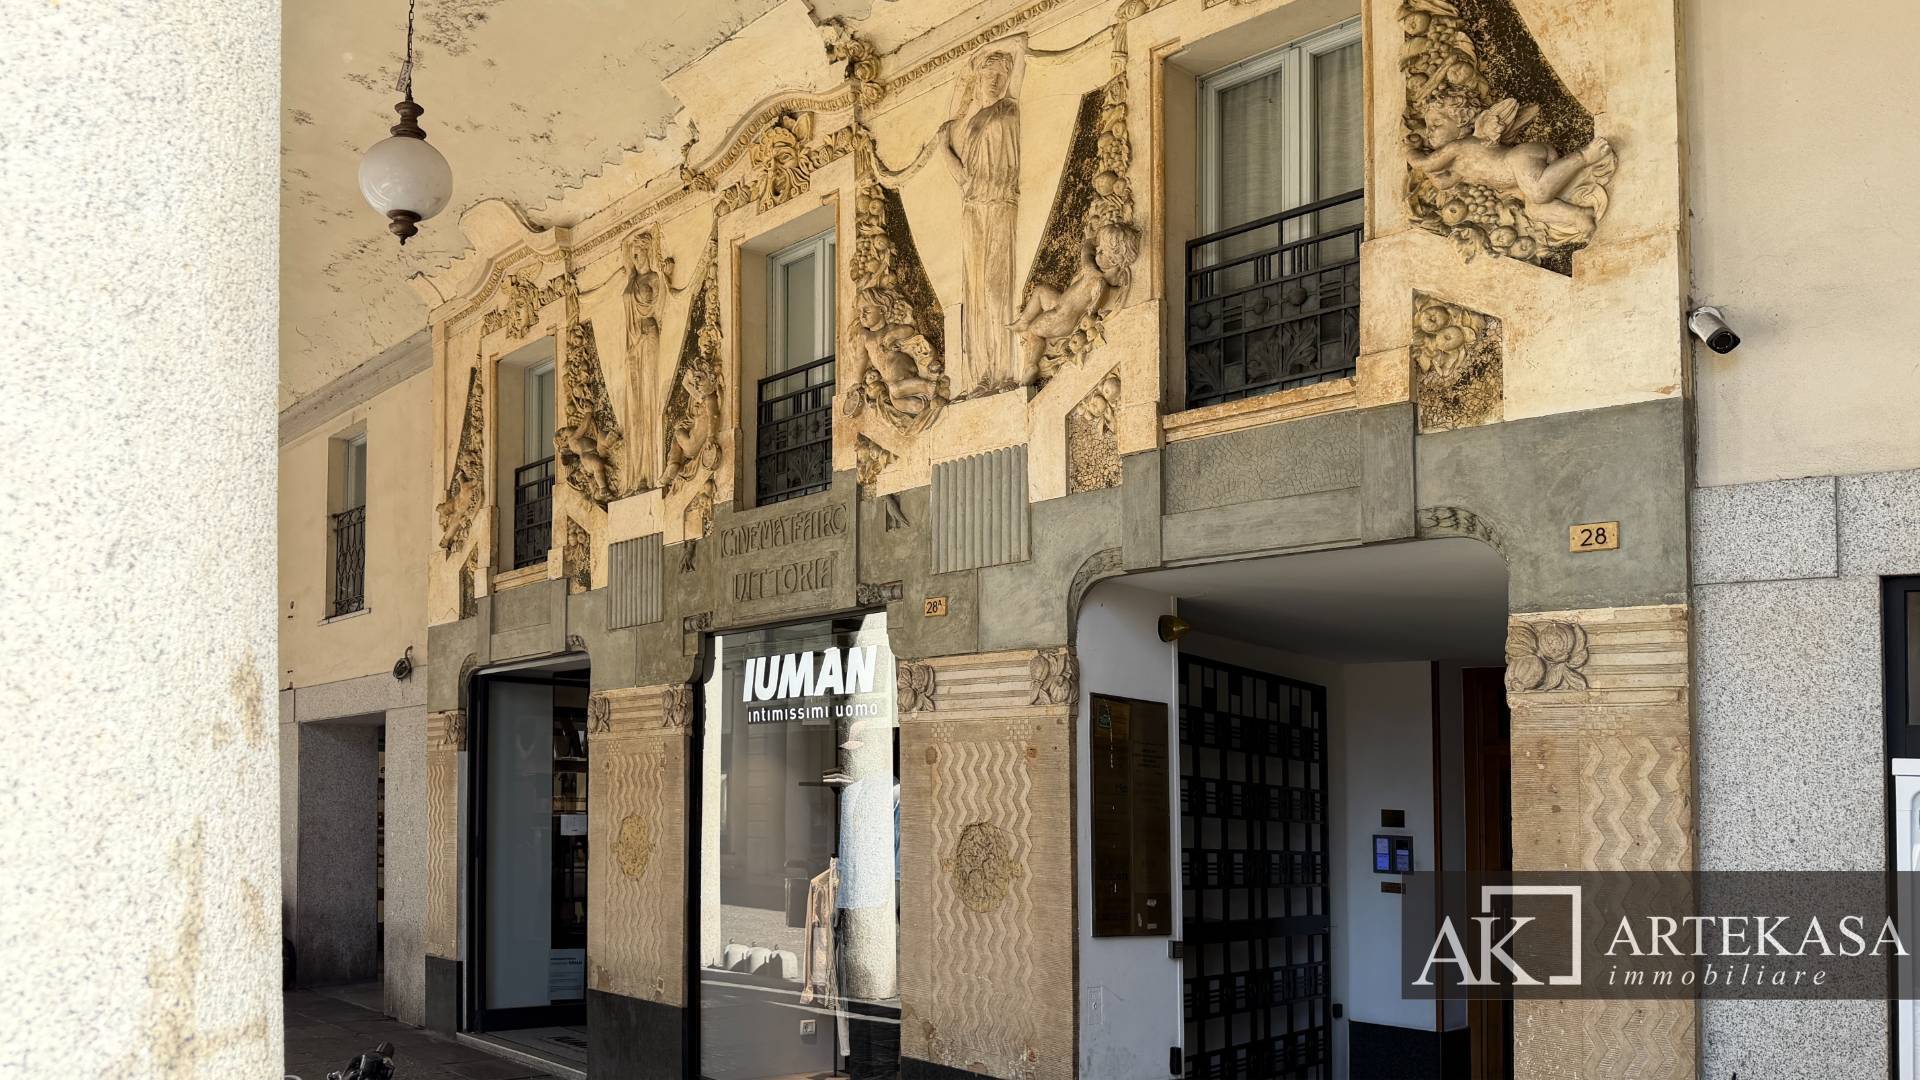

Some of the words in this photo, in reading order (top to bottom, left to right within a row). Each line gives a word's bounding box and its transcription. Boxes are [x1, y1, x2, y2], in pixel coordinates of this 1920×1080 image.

[1580, 527, 1607, 547] 28
[743, 645, 878, 702] IUMAN
[748, 706, 829, 723] intimissimi
[835, 702, 878, 718] uomo
